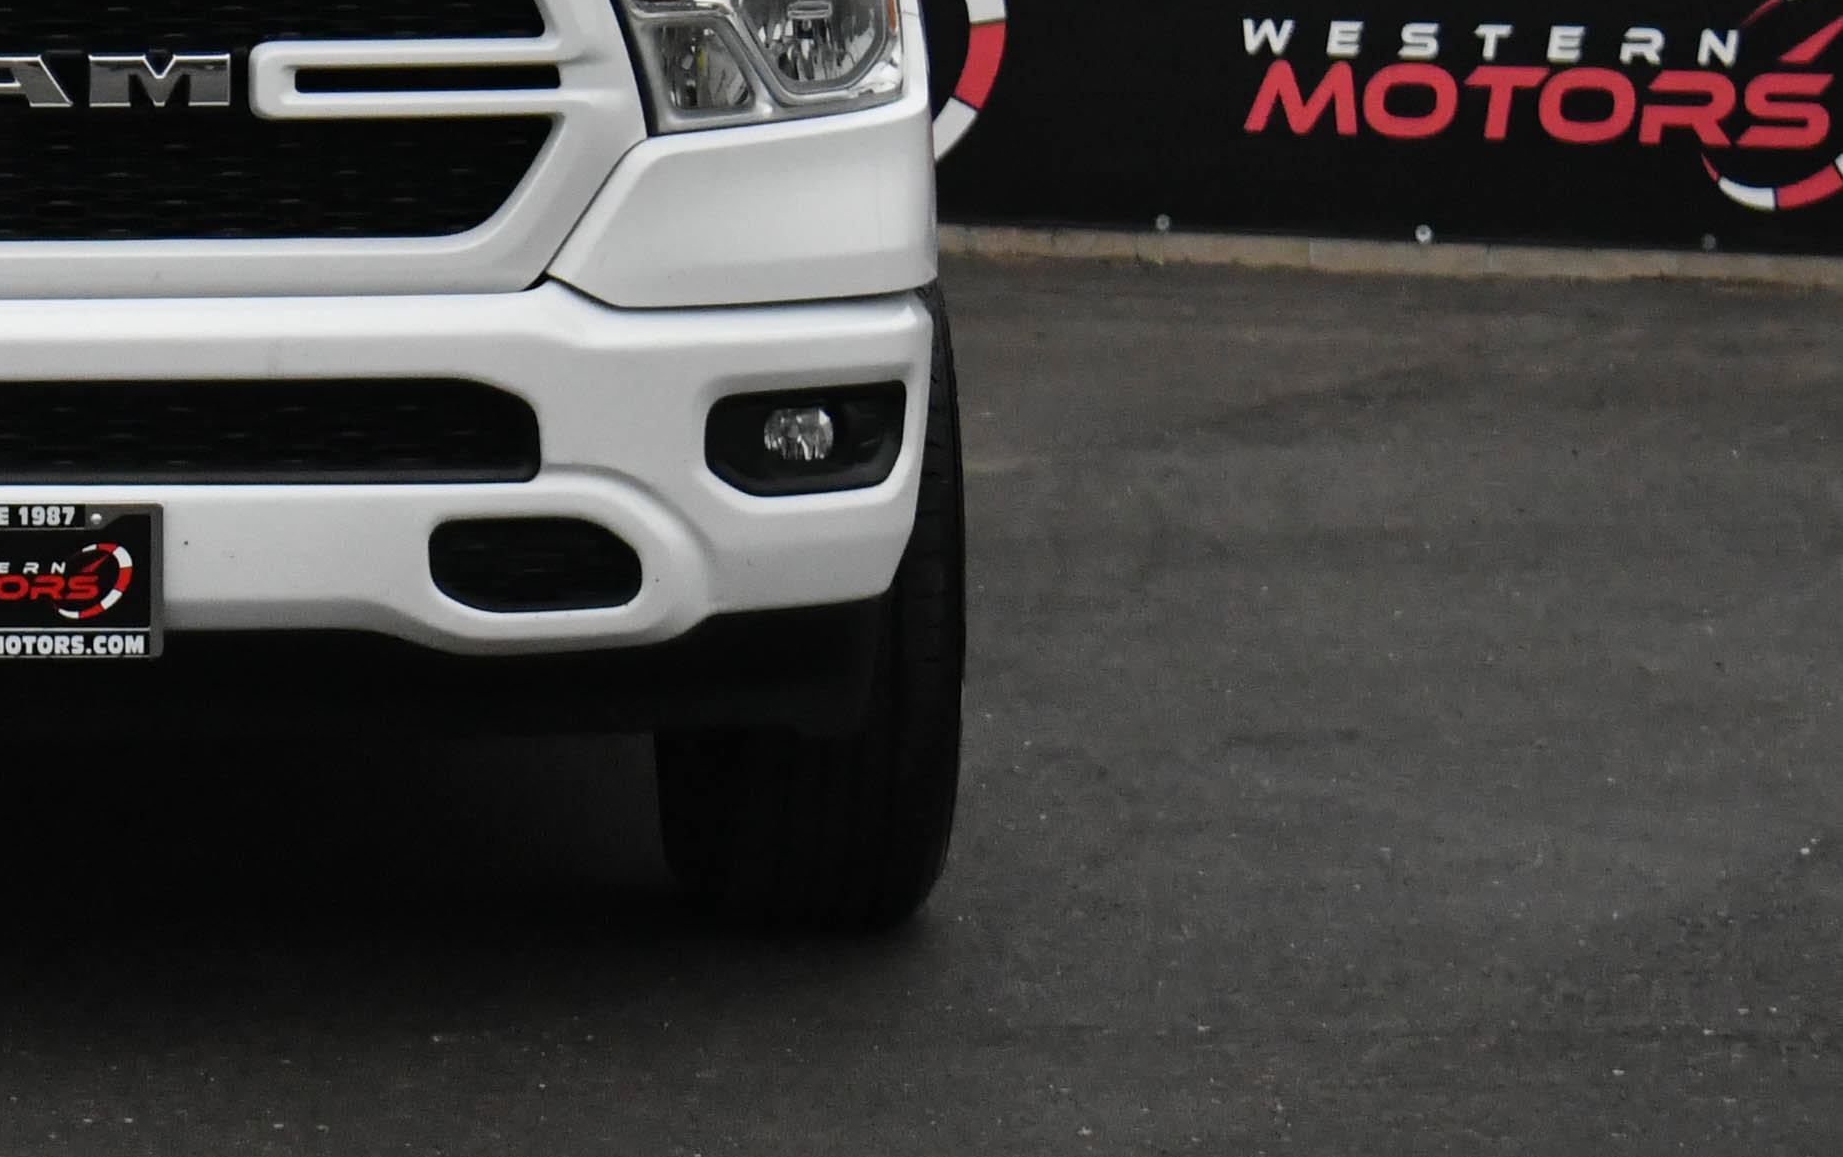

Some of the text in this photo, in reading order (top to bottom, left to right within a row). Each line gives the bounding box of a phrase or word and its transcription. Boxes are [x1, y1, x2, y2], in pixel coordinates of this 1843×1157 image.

[1242, 18, 1739, 65] WESTERN
[1244, 58, 1833, 149] MOTORS
[19, 506, 75, 526] 1987
